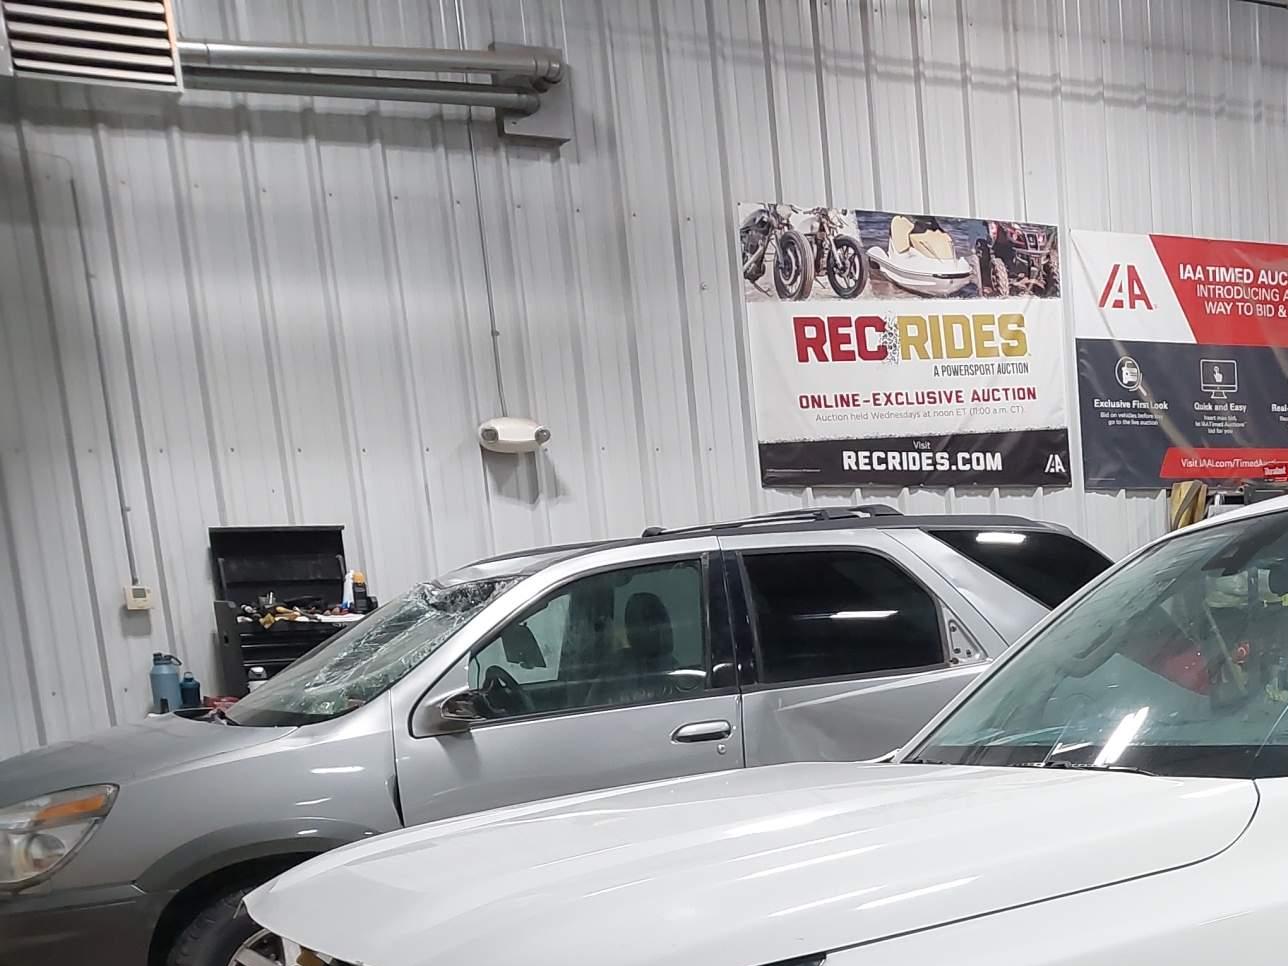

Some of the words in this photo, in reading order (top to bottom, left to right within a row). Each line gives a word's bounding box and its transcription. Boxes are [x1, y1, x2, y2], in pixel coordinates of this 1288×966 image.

[1179, 263, 1205, 281] IAA
[1206, 266, 1254, 284] TIMED
[1196, 284, 1280, 302] INTRODUCING
[1204, 301, 1233, 315] WAY
[1236, 302, 1253, 316] TO
[1256, 303, 1275, 317] BID
[1277, 304, 1288, 318] &
[897, 313, 1028, 361] RIDES
[933, 366, 941, 378] A
[941, 363, 995, 377] POWERSPORT
[997, 362, 1029, 375] AUCTION
[799, 390, 965, 410] ONLINE-EXCLUSIVE
[971, 386, 1037, 403] AUCTION
[1094, 399, 1131, 409] Exclusive
[1132, 399, 1150, 409] First
[1150, 400, 1168, 410] Look
[815, 412, 848, 422] Auction
[851, 411, 868, 421] held
[871, 410, 921, 421] Wednesdays
[923, 410, 931, 418] at
[956, 408, 967, 417] ET
[1010, 405, 1025, 415] CT)
[1193, 401, 1212, 411] Quick
[1214, 403, 1228, 411] and
[1229, 402, 1247, 413] Easy
[913, 439, 931, 450] Visit
[842, 451, 1003, 472] RECRIDES.COM
[1181, 458, 1198, 468] Visit
